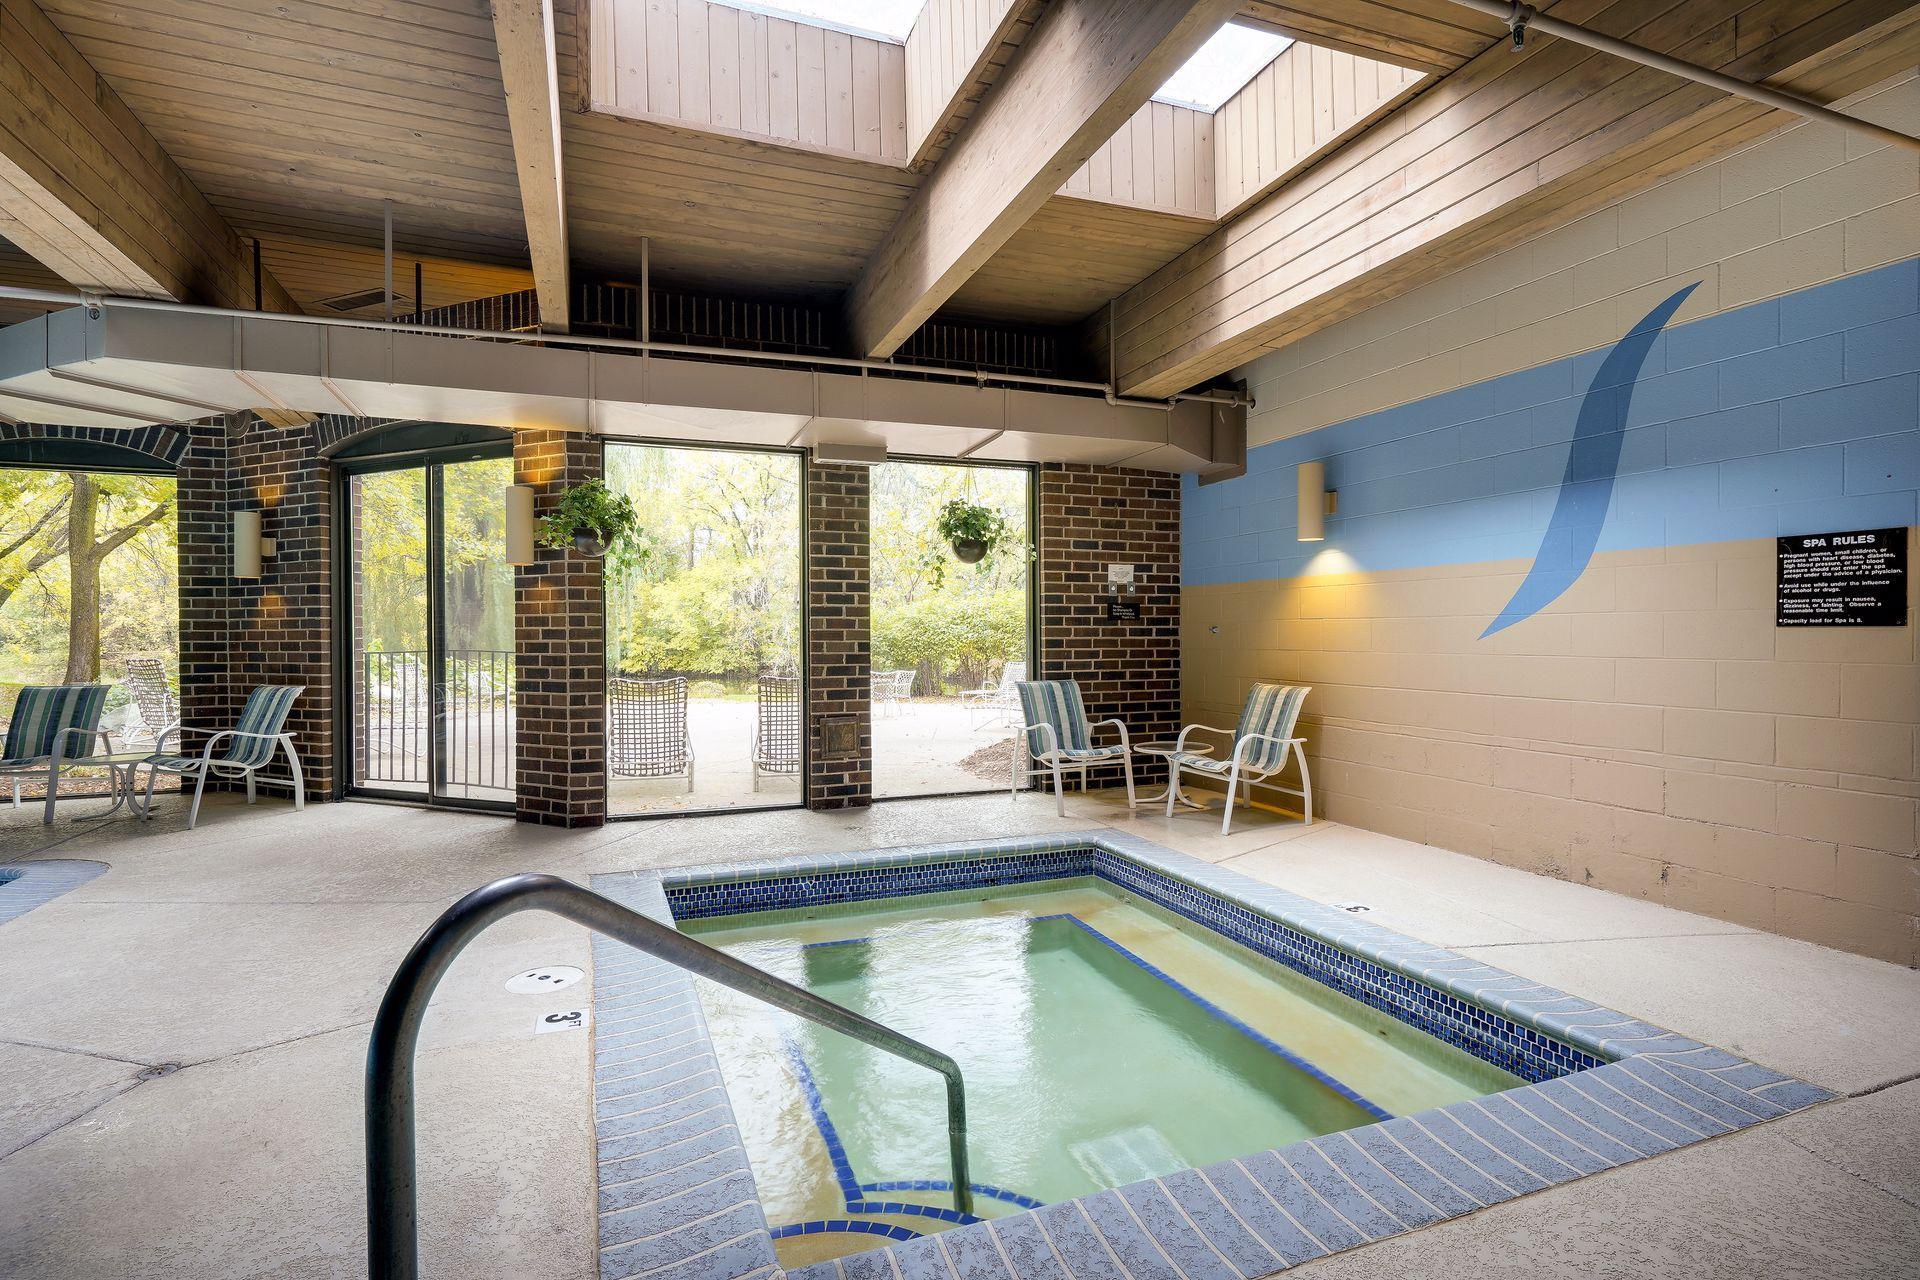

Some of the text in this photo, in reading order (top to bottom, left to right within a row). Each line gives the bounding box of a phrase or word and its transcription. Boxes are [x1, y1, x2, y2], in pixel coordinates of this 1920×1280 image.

[1803, 535, 1875, 548] SPA RULES
[545, 1011, 581, 1023] 3
